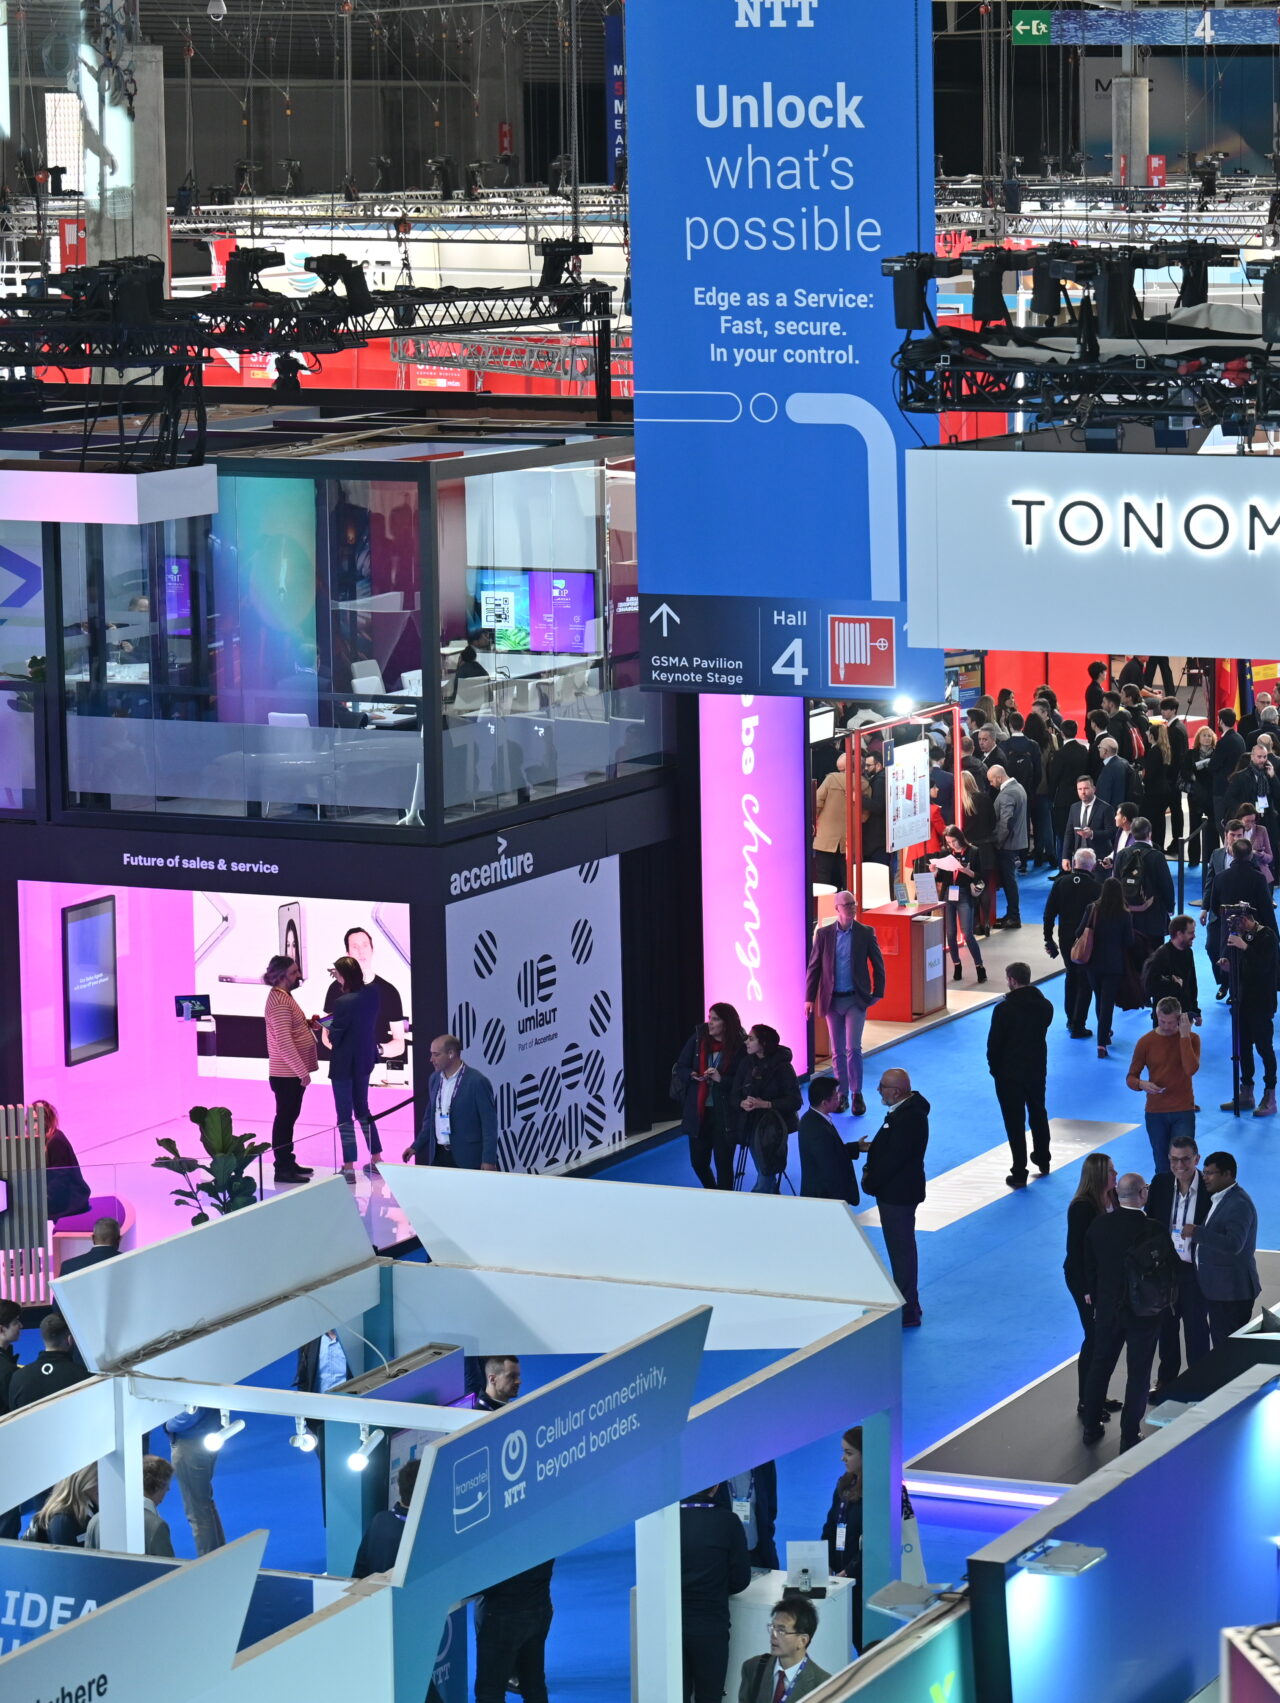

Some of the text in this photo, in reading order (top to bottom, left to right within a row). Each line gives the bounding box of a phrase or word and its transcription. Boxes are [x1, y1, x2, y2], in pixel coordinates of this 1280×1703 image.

[735, 0, 818, 28] NTT
[1194, 10, 1215, 43] 4
[695, 82, 865, 129] Unlock
[685, 205, 882, 260] possible
[694, 287, 874, 310] Edge as a Service:
[720, 315, 847, 337] Fast, secure.
[710, 343, 860, 366] In your control.
[773, 610, 807, 626] Hall
[651, 655, 743, 670] GSMA Pavilion
[771, 637, 809, 686] 4
[651, 670, 744, 686] Keynote Stage
[123, 853, 279, 875] Future of sales & service
[450, 850, 534, 896] accenture
[734, 793, 772, 1002] change
[534, 1031, 558, 1047] Accenture
[535, 1365, 667, 1449] Cellular connectivity,
[536, 1412, 641, 1483] beyond borders.
[455, 1468, 488, 1496] transatel
[503, 1480, 527, 1508] NTT
